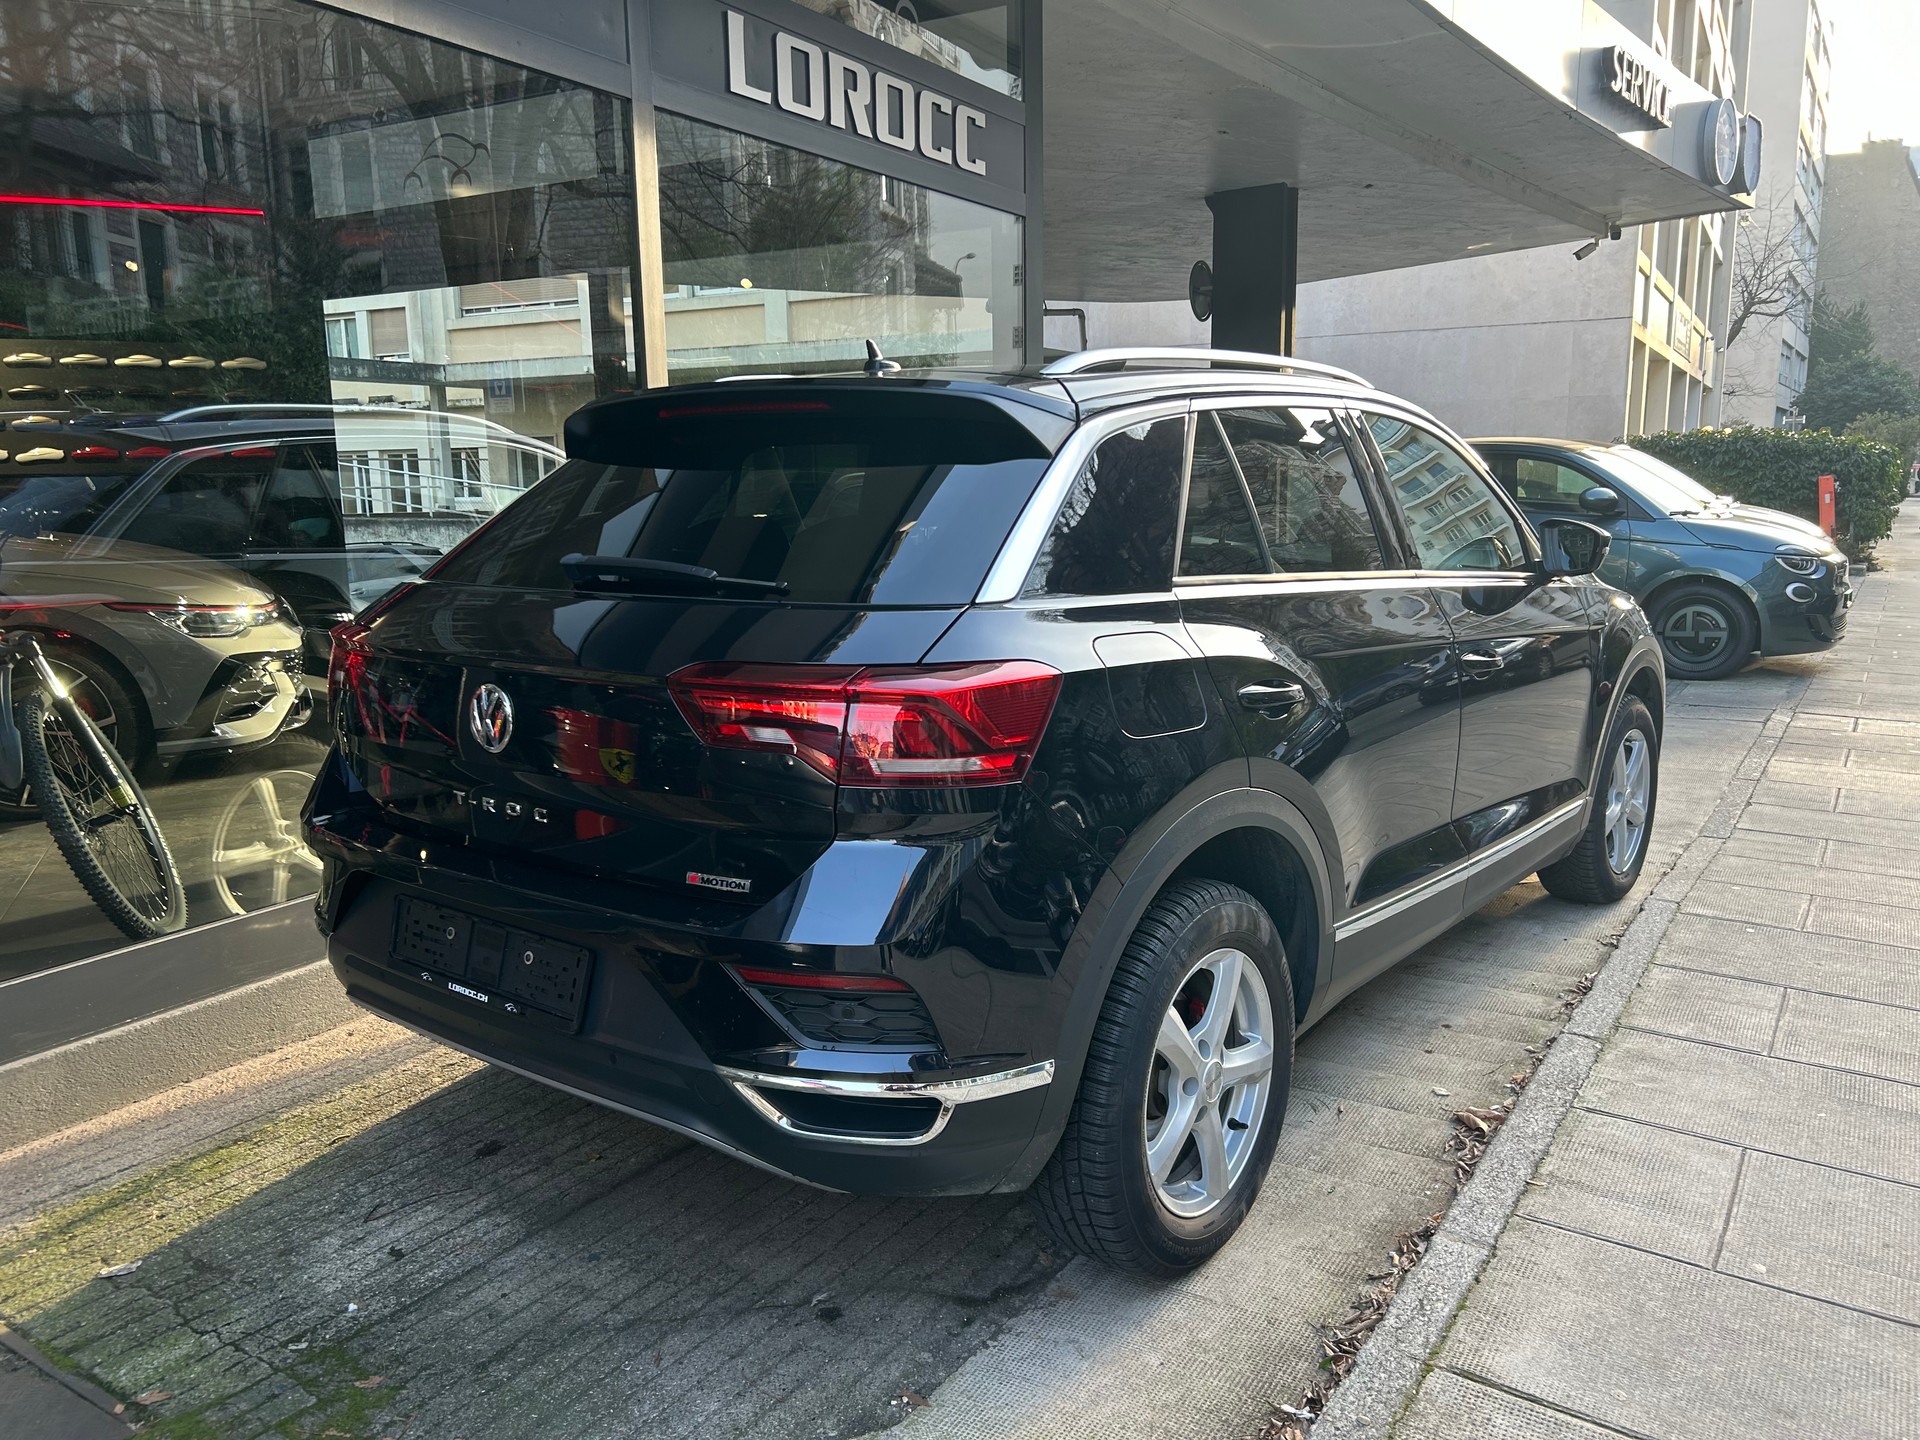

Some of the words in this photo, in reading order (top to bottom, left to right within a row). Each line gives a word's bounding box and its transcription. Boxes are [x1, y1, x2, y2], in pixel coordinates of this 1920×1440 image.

[727, 9, 986, 176] LOROCC
[1611, 45, 1673, 128] SERVICE
[448, 982, 489, 1003] LOROCC.CH
